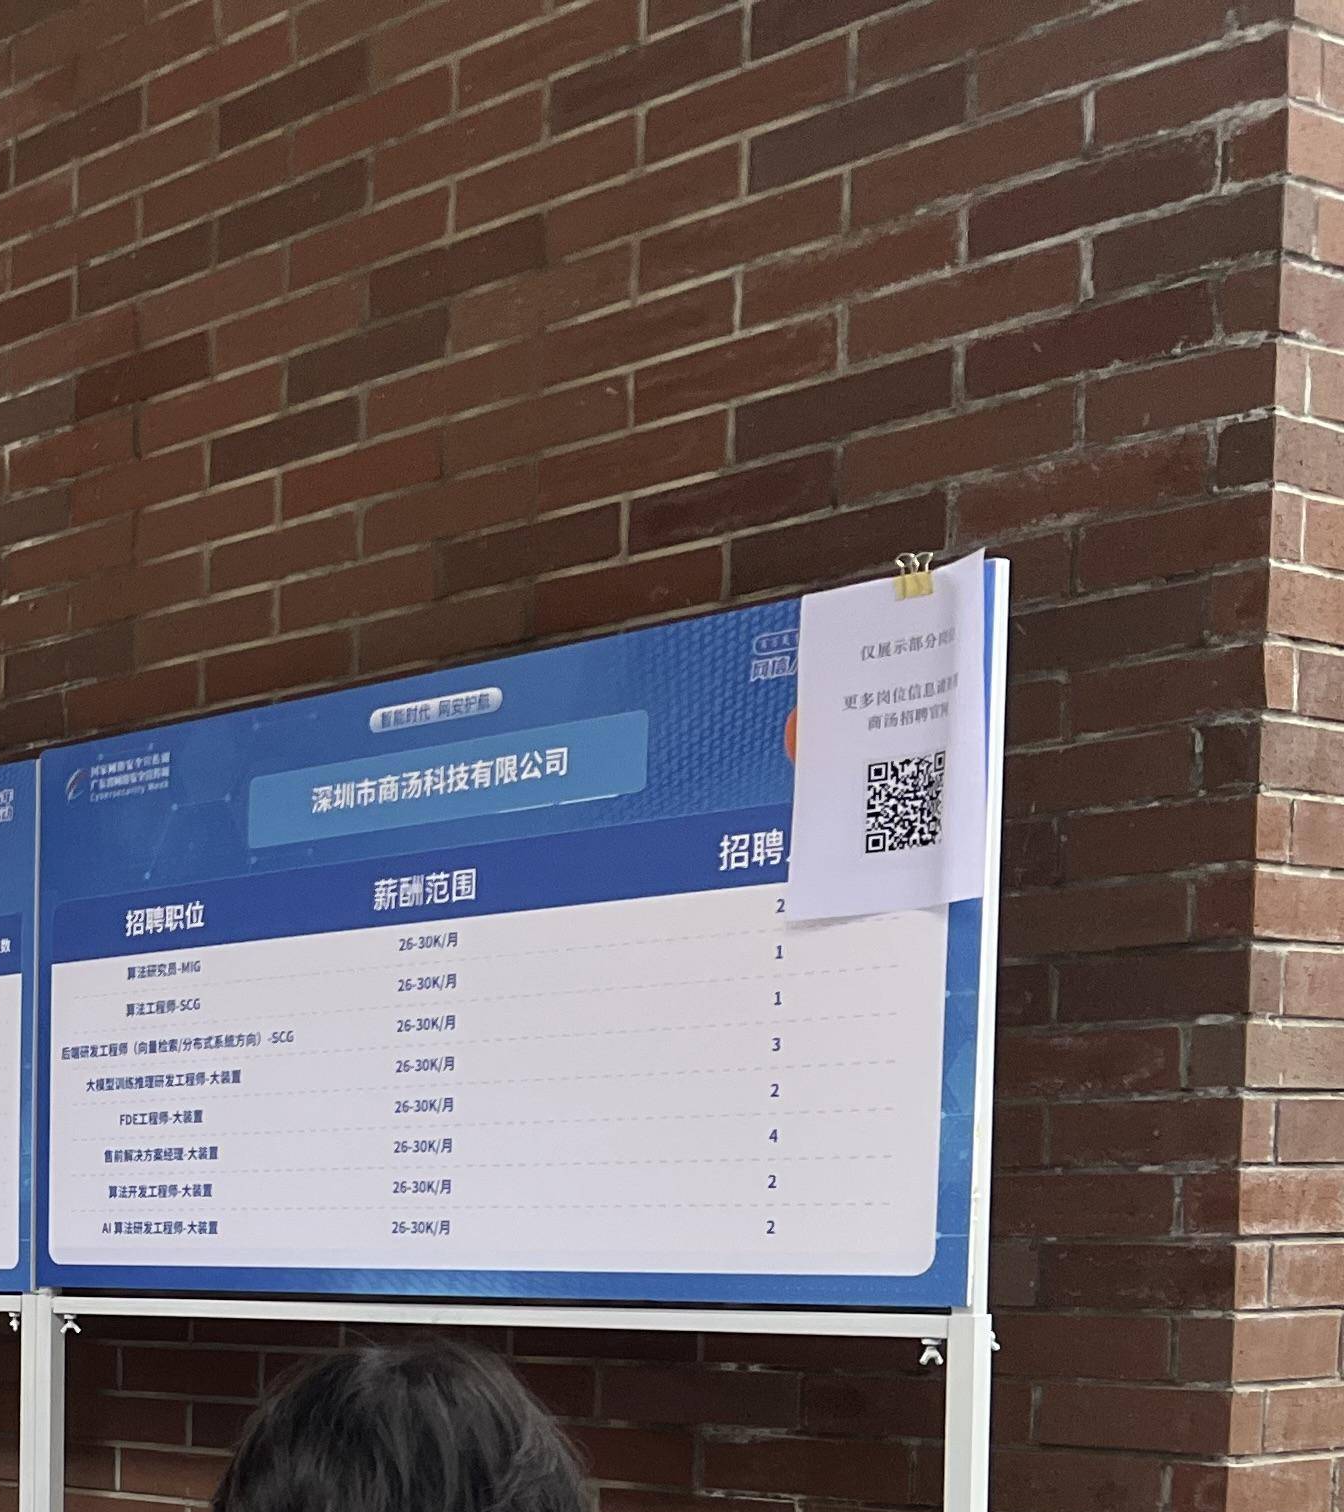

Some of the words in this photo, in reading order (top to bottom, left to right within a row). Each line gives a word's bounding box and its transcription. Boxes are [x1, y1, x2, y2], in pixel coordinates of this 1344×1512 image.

[311, 746, 569, 814] 深圳市商汤科技有限公司
[719, 827, 792, 871] 招聘
[373, 867, 477, 911] 薪酬范围
[775, 898, 786, 913] 2
[125, 900, 205, 937] 招聘职位
[399, 932, 459, 951] 26-30K/月
[775, 945, 784, 959] 1
[127, 960, 201, 980] 算法研究员-MIG
[398, 973, 457, 991] 26-30K/月
[773, 991, 782, 1006] 1
[126, 998, 201, 1017] 算法工程师-SCG
[396, 1015, 456, 1032] 26-30K/月
[771, 1037, 781, 1052] 3
[395, 1056, 455, 1073] 26-30K/月
[770, 1083, 780, 1098] 2
[394, 1097, 454, 1113] 26-30K/月
[119, 1109, 203, 1126] FDE工程师-大装置
[768, 1129, 778, 1143] 4
[393, 1138, 453, 1153] 26-30K/月
[392, 1179, 452, 1194] 26-30K/月
[767, 1175, 777, 1189] 2
[108, 1184, 213, 1199] 算法开发工程师-大装置
[102, 1222, 112, 1234] AI
[114, 1220, 218, 1235] 算法研发工程师-大装置
[391, 1220, 450, 1235] 26-30K/月
[766, 1220, 776, 1235] 2
